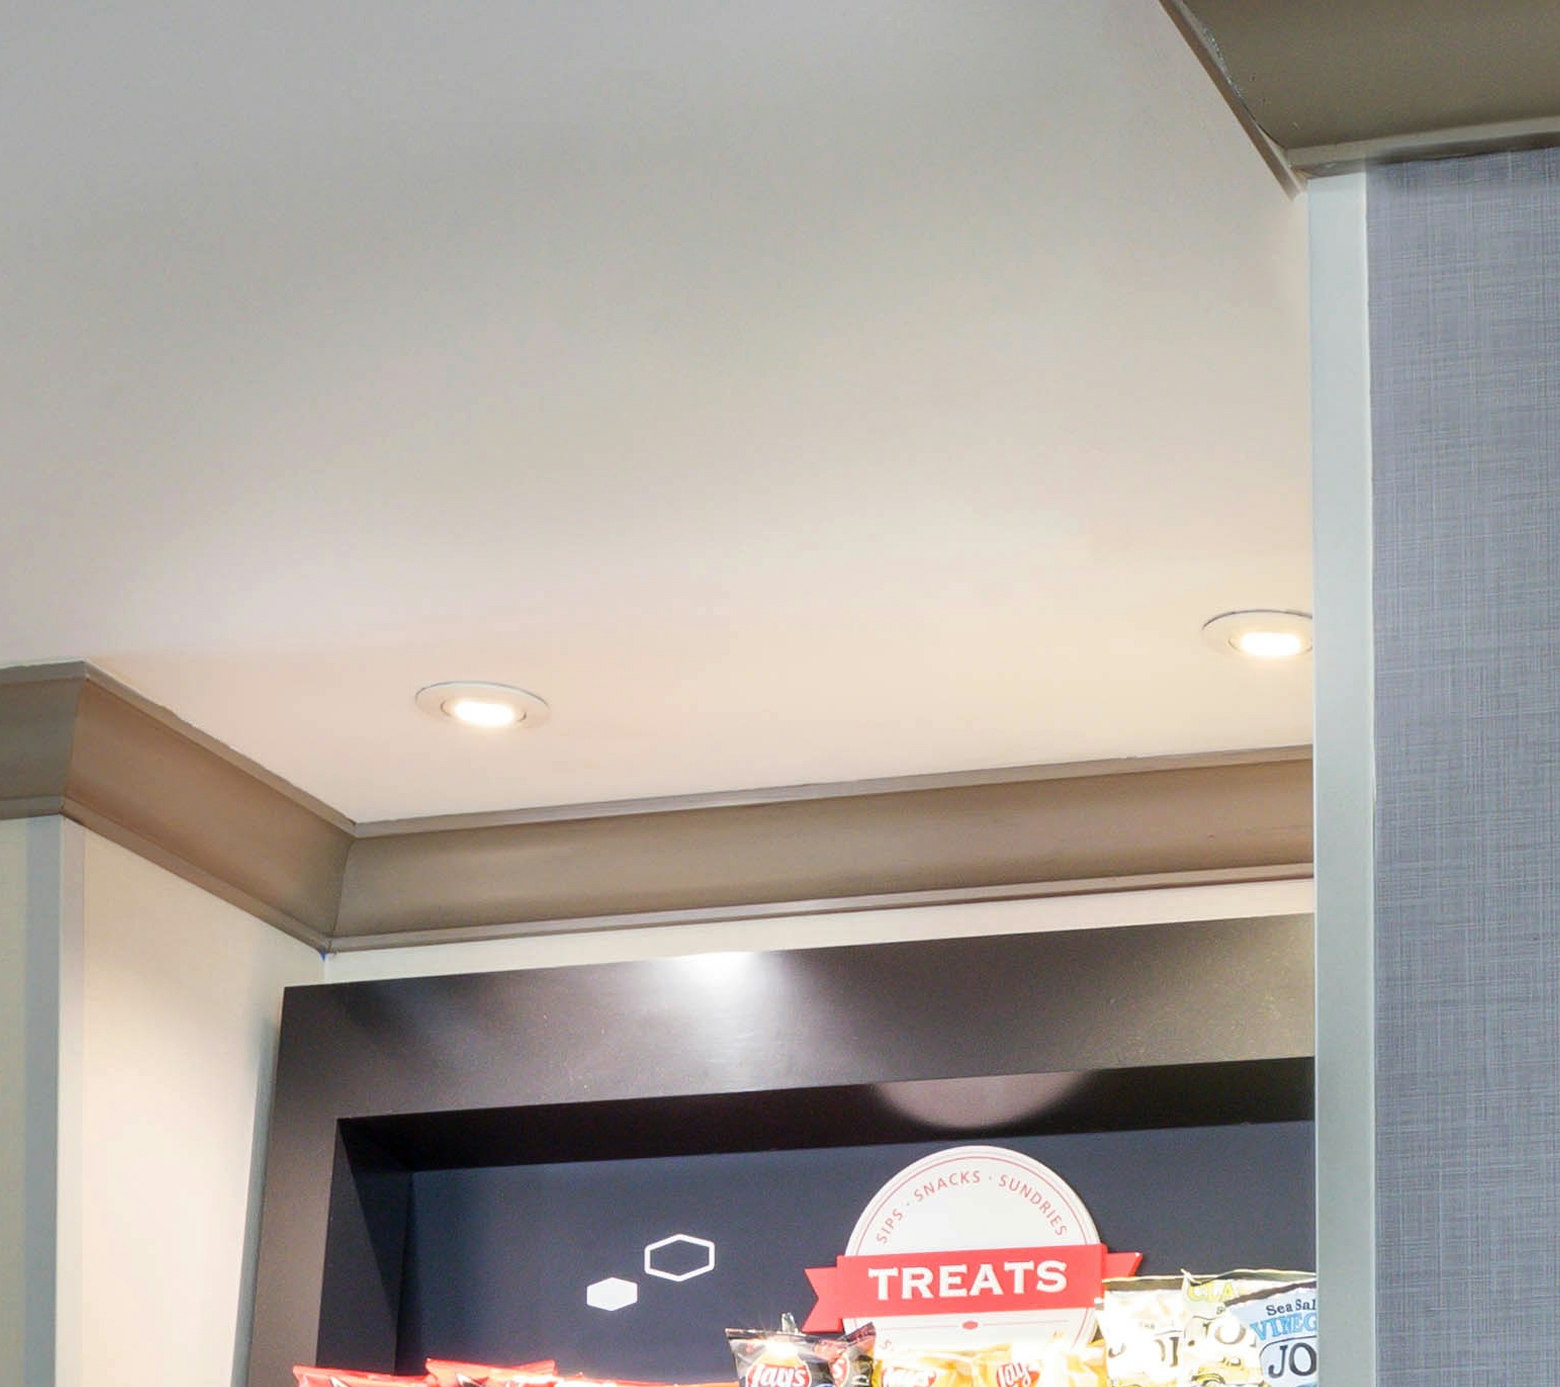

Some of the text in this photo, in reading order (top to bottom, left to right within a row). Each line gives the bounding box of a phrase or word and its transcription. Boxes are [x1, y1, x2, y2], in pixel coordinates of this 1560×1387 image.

[875, 1169, 1069, 1245] SIPS SNACKS SUNDRIES
[867, 1259, 1069, 1301] TREATS
[1296, 1299, 1316, 1312] Sal
[1250, 1311, 1316, 1341] VINEG
[1268, 1342, 1316, 1379] JO
